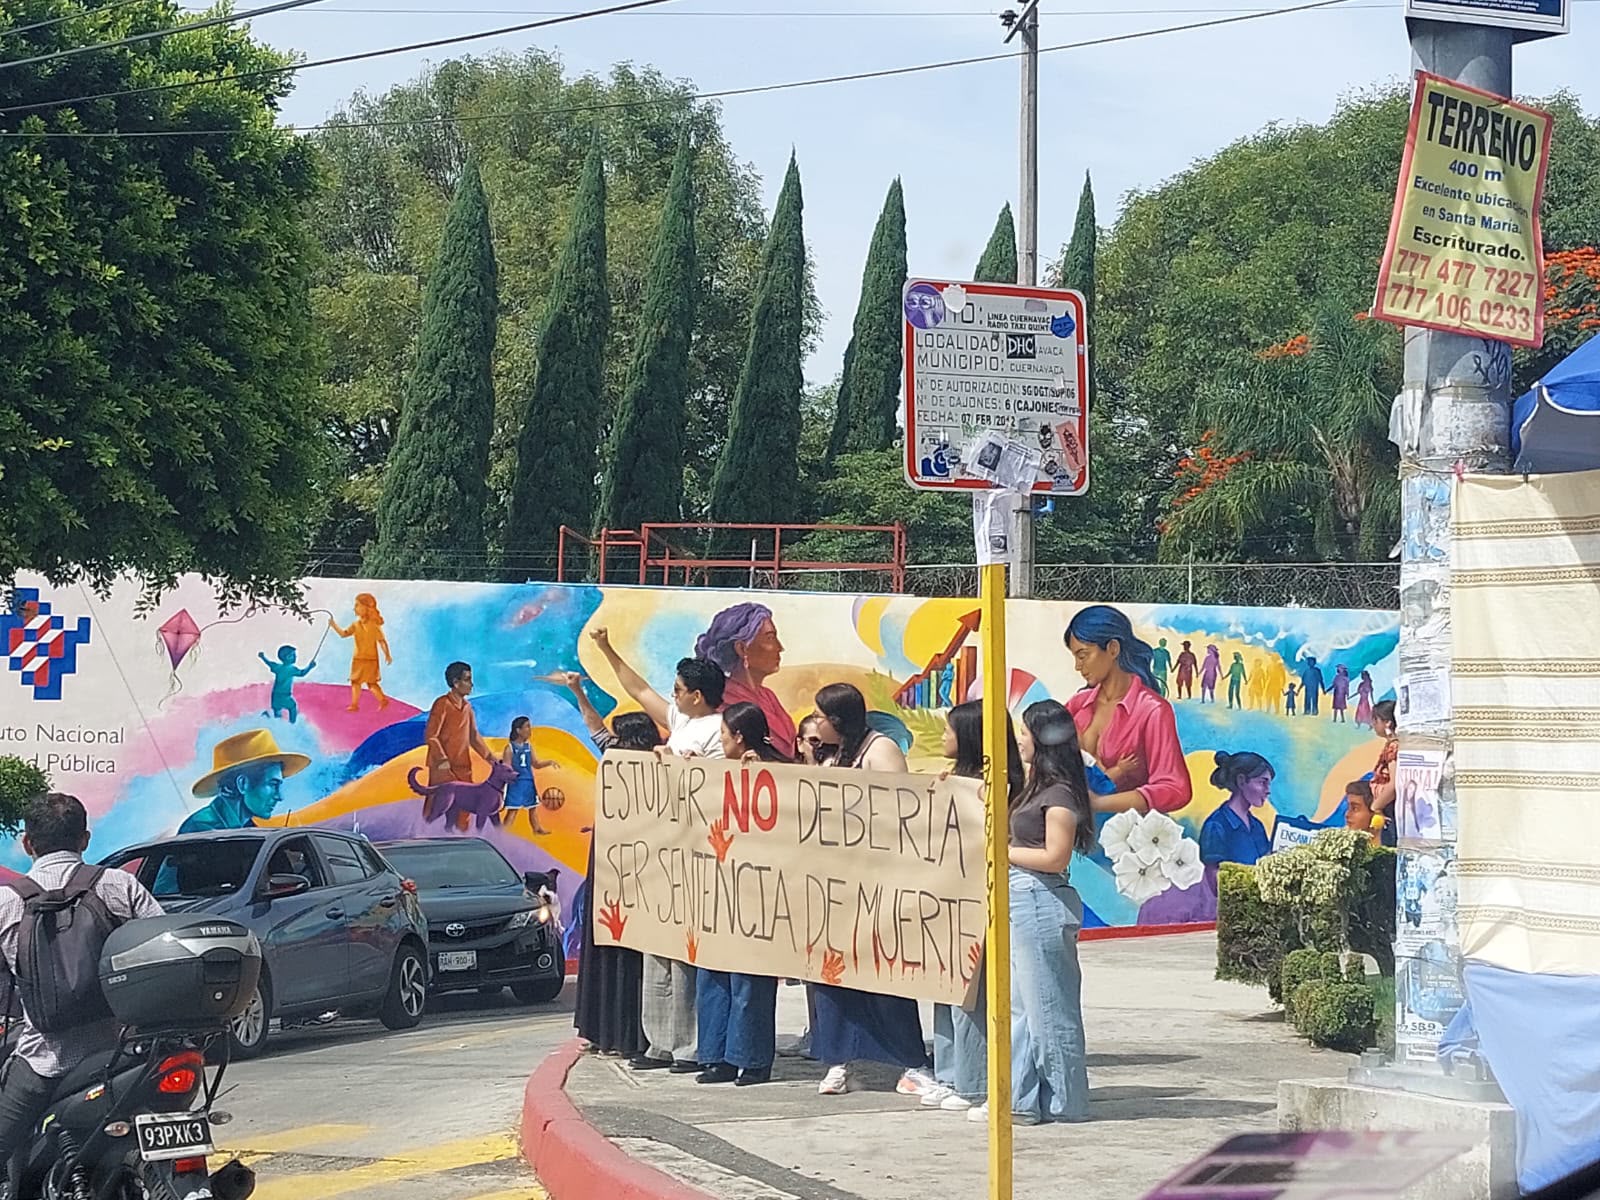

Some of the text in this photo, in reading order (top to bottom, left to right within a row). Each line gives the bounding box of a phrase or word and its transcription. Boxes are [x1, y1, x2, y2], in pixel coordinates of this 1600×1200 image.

[1427, 91, 1536, 171] TERRENO
[1448, 160, 1478, 178] 400
[1413, 175, 1529, 218] Excelente ubican
[1423, 205, 1435, 218] en
[1438, 207, 1476, 226] Santa
[1413, 226, 1525, 261] Escriturado.
[1395, 248, 1535, 298] 777 477 7227
[1389, 282, 1530, 333] 777 106 0233
[987, 321, 1049, 332] RADIO TAXI QUINT
[1009, 314, 1051, 324] CUERNAVAC
[916, 331, 1005, 353] LOCALIDAD:
[917, 352, 1065, 375] MUNICIPIO: CUERNAVACA
[930, 379, 943, 391] DE
[946, 380, 1020, 395] AUTORIZACIÓN:
[931, 395, 945, 407] DE
[949, 396, 1001, 410] CAJONES:
[1005, 399, 1011, 410] 6
[917, 410, 958, 423] FECHA:
[37, 724, 124, 744] Nacional
[47, 753, 115, 773] Pública
[520, 753, 527, 767] 1
[602, 759, 966, 878] ESTUDIAR NO DEBERÍA
[604, 840, 982, 981] SER SENTENCIA DE MUERTE
[199, 926, 233, 936] YAMAHA
[145, 1122, 204, 1147] 93PXK3
